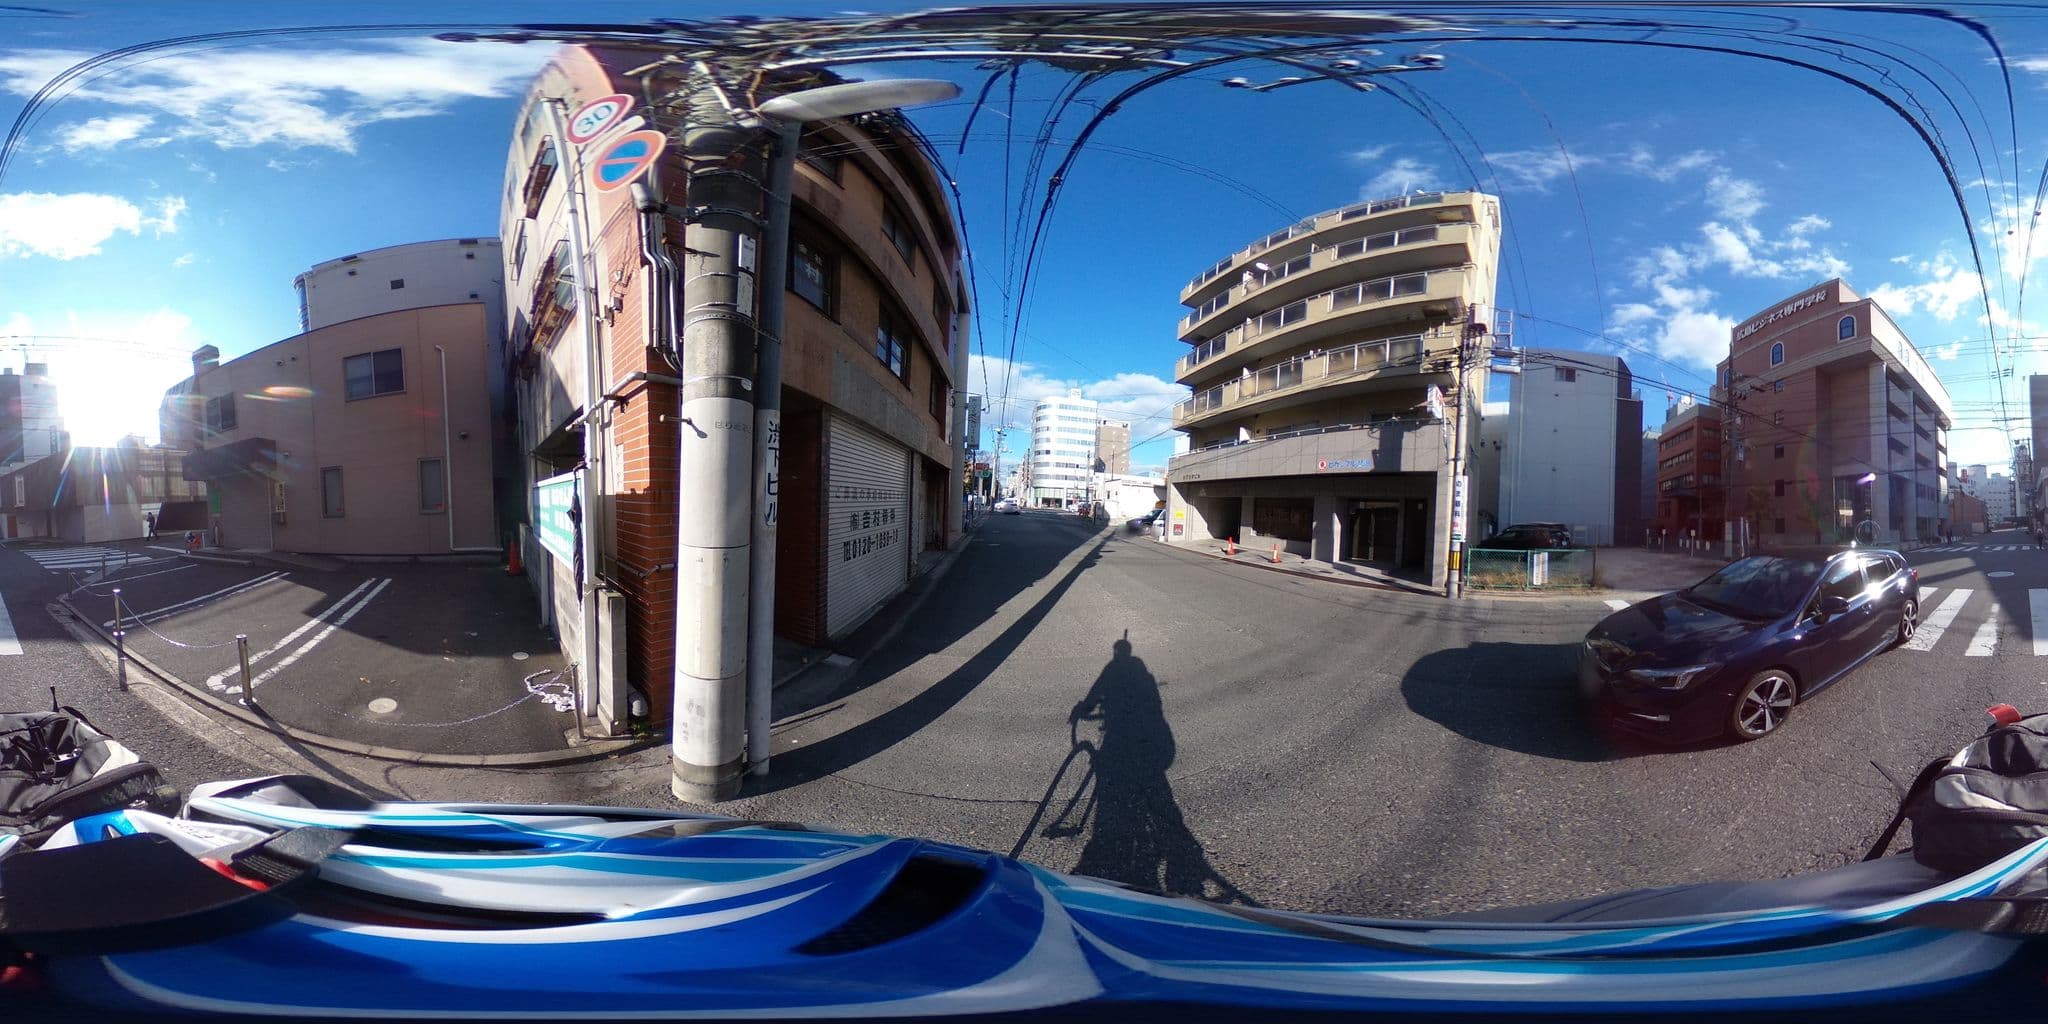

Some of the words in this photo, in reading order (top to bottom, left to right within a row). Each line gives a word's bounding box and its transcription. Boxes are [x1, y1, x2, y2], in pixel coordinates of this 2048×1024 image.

[577, 104, 613, 134] 30
[1736, 290, 1828, 342] 広島ビジネス専門学校
